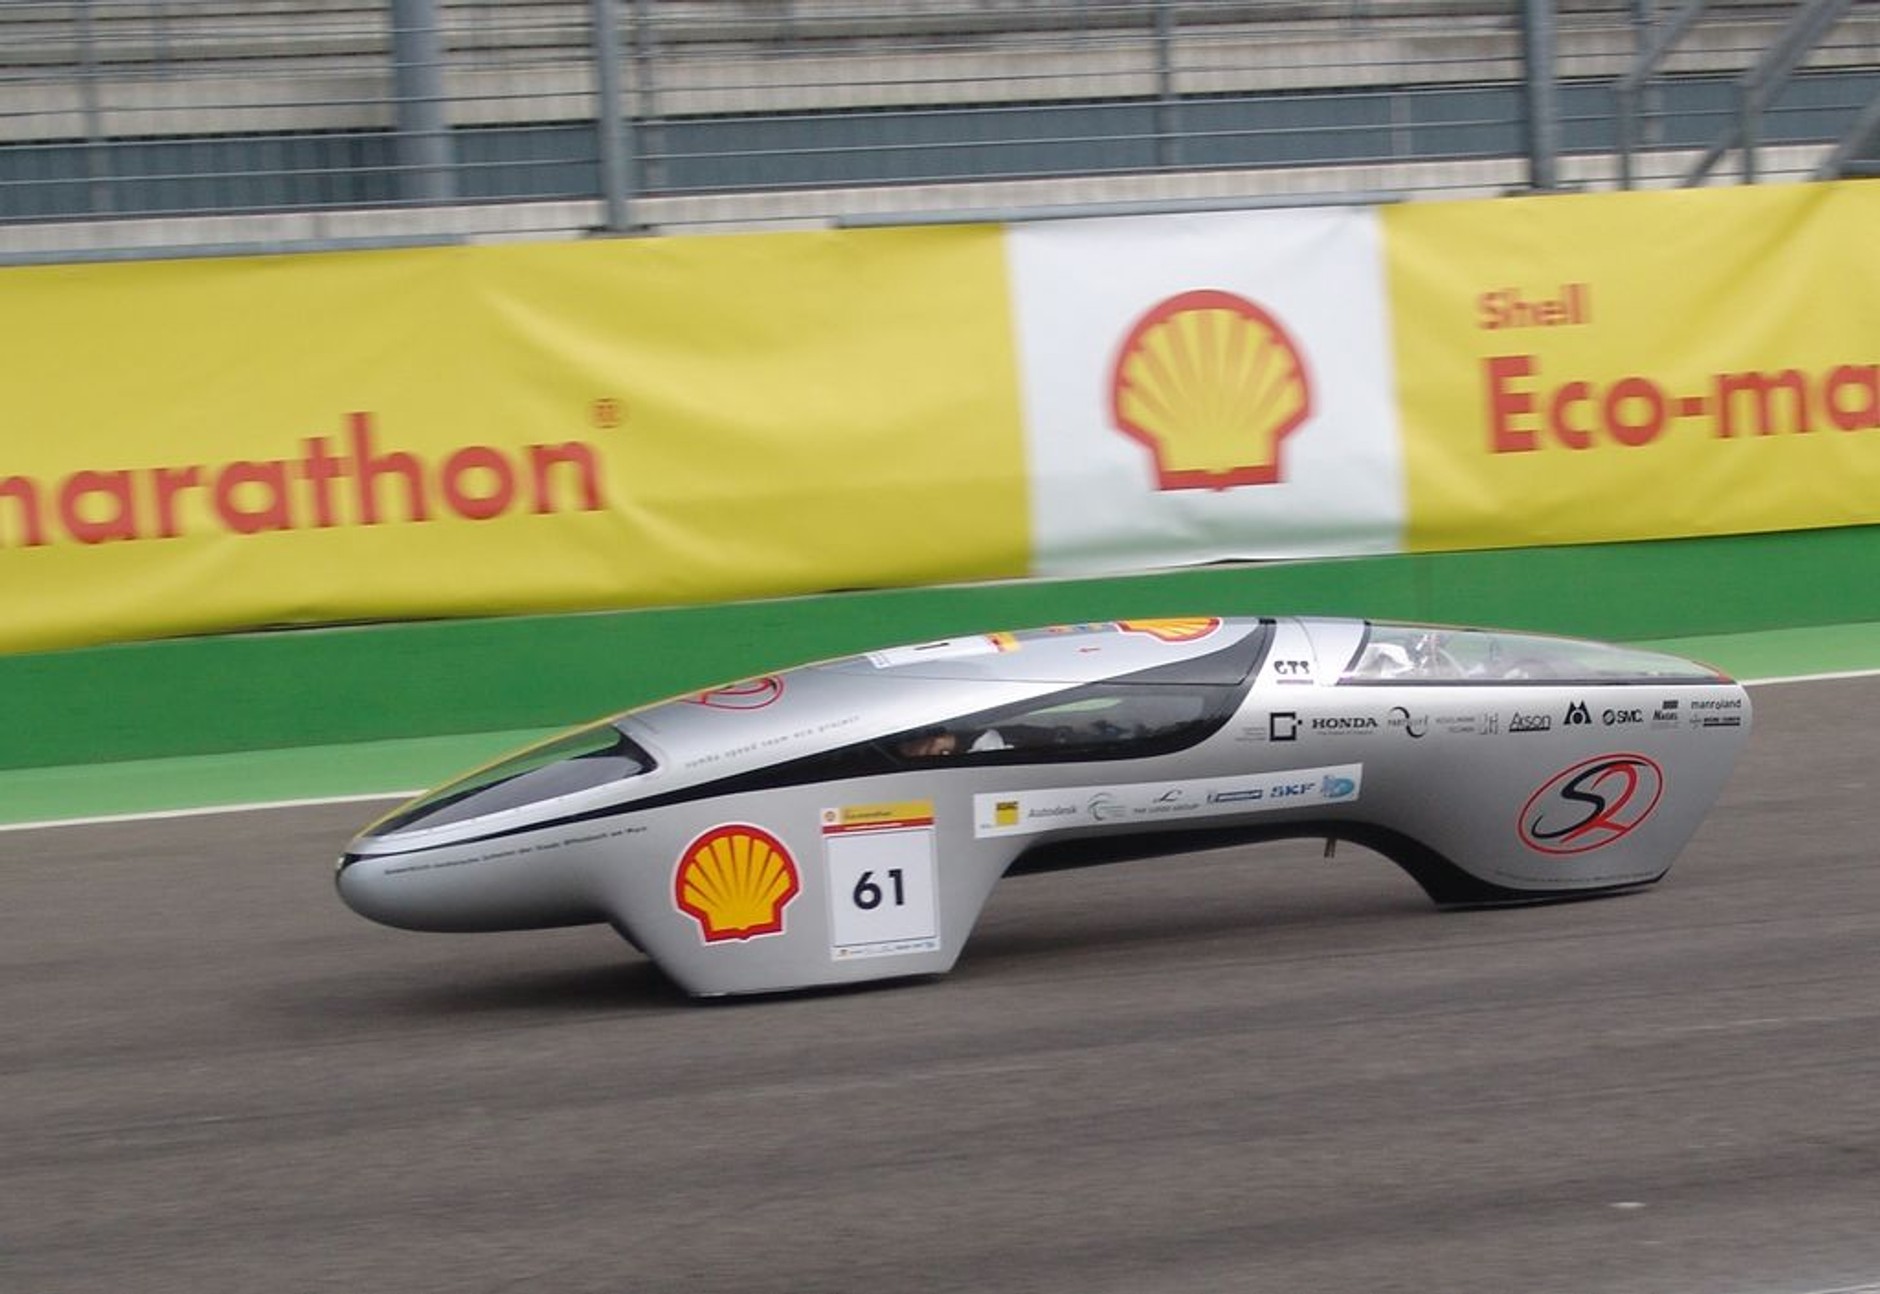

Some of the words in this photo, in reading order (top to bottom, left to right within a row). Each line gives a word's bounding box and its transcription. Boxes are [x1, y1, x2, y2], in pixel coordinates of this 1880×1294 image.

[1479, 283, 1591, 330] Shell
[1312, 717, 1379, 729] HONDA
[1270, 782, 1315, 798] SKF
[853, 868, 905, 910] 61
